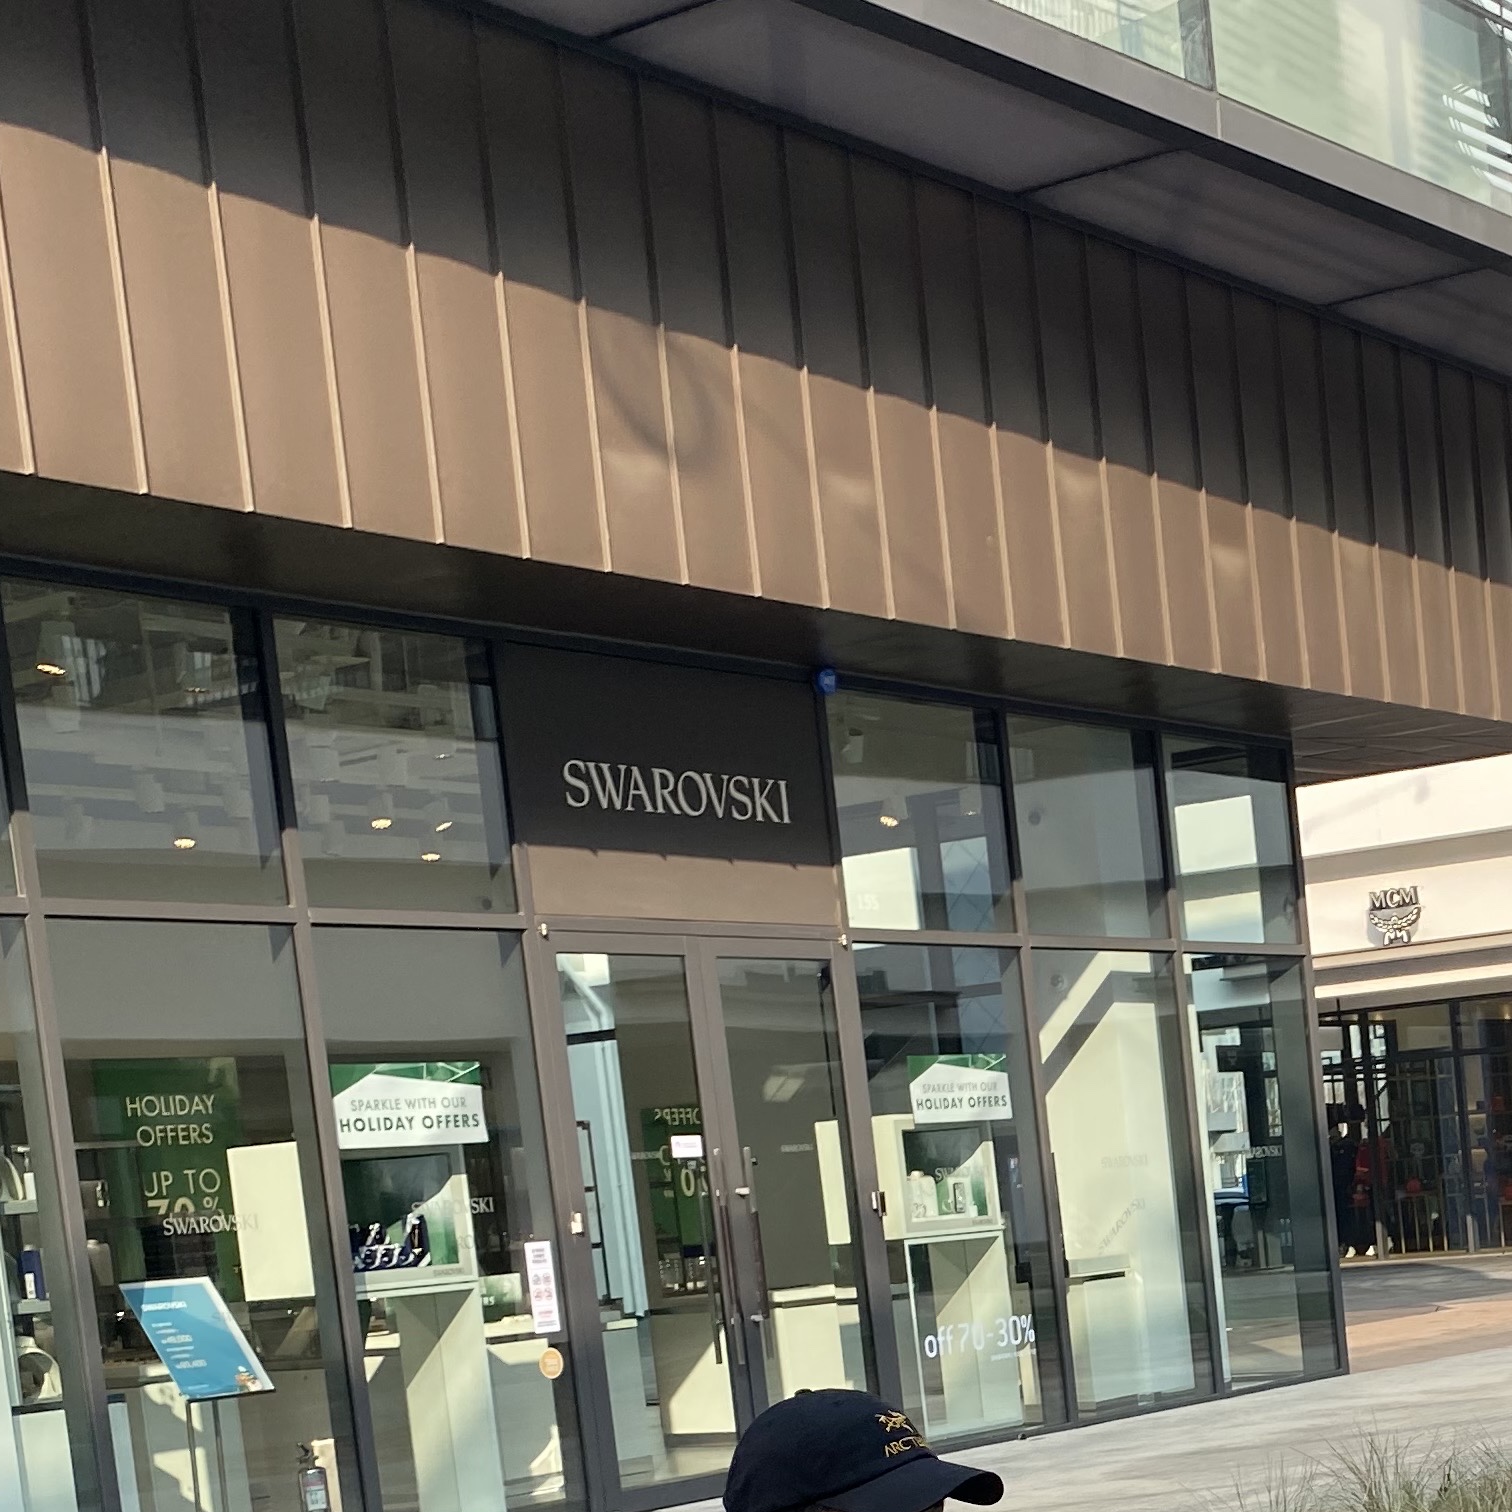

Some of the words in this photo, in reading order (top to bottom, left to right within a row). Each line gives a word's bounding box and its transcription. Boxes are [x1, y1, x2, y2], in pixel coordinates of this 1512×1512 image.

[563, 759, 791, 824] SWAROVSKI
[1369, 885, 1420, 911] MCM
[126, 1094, 215, 1117] HOLIDAY
[351, 1099, 401, 1112] SPARKLE
[406, 1098, 437, 1110] WITH
[441, 1096, 467, 1109] OUR
[916, 1097, 963, 1110] HOLIDAY
[968, 1095, 1008, 1108] OFFERS
[137, 1123, 214, 1147] OFFERS
[340, 1116, 415, 1133] HOLIDAY
[422, 1113, 480, 1130] OFFERS
[183, 1168, 221, 1194] TO
[924, 1323, 954, 1358] off
